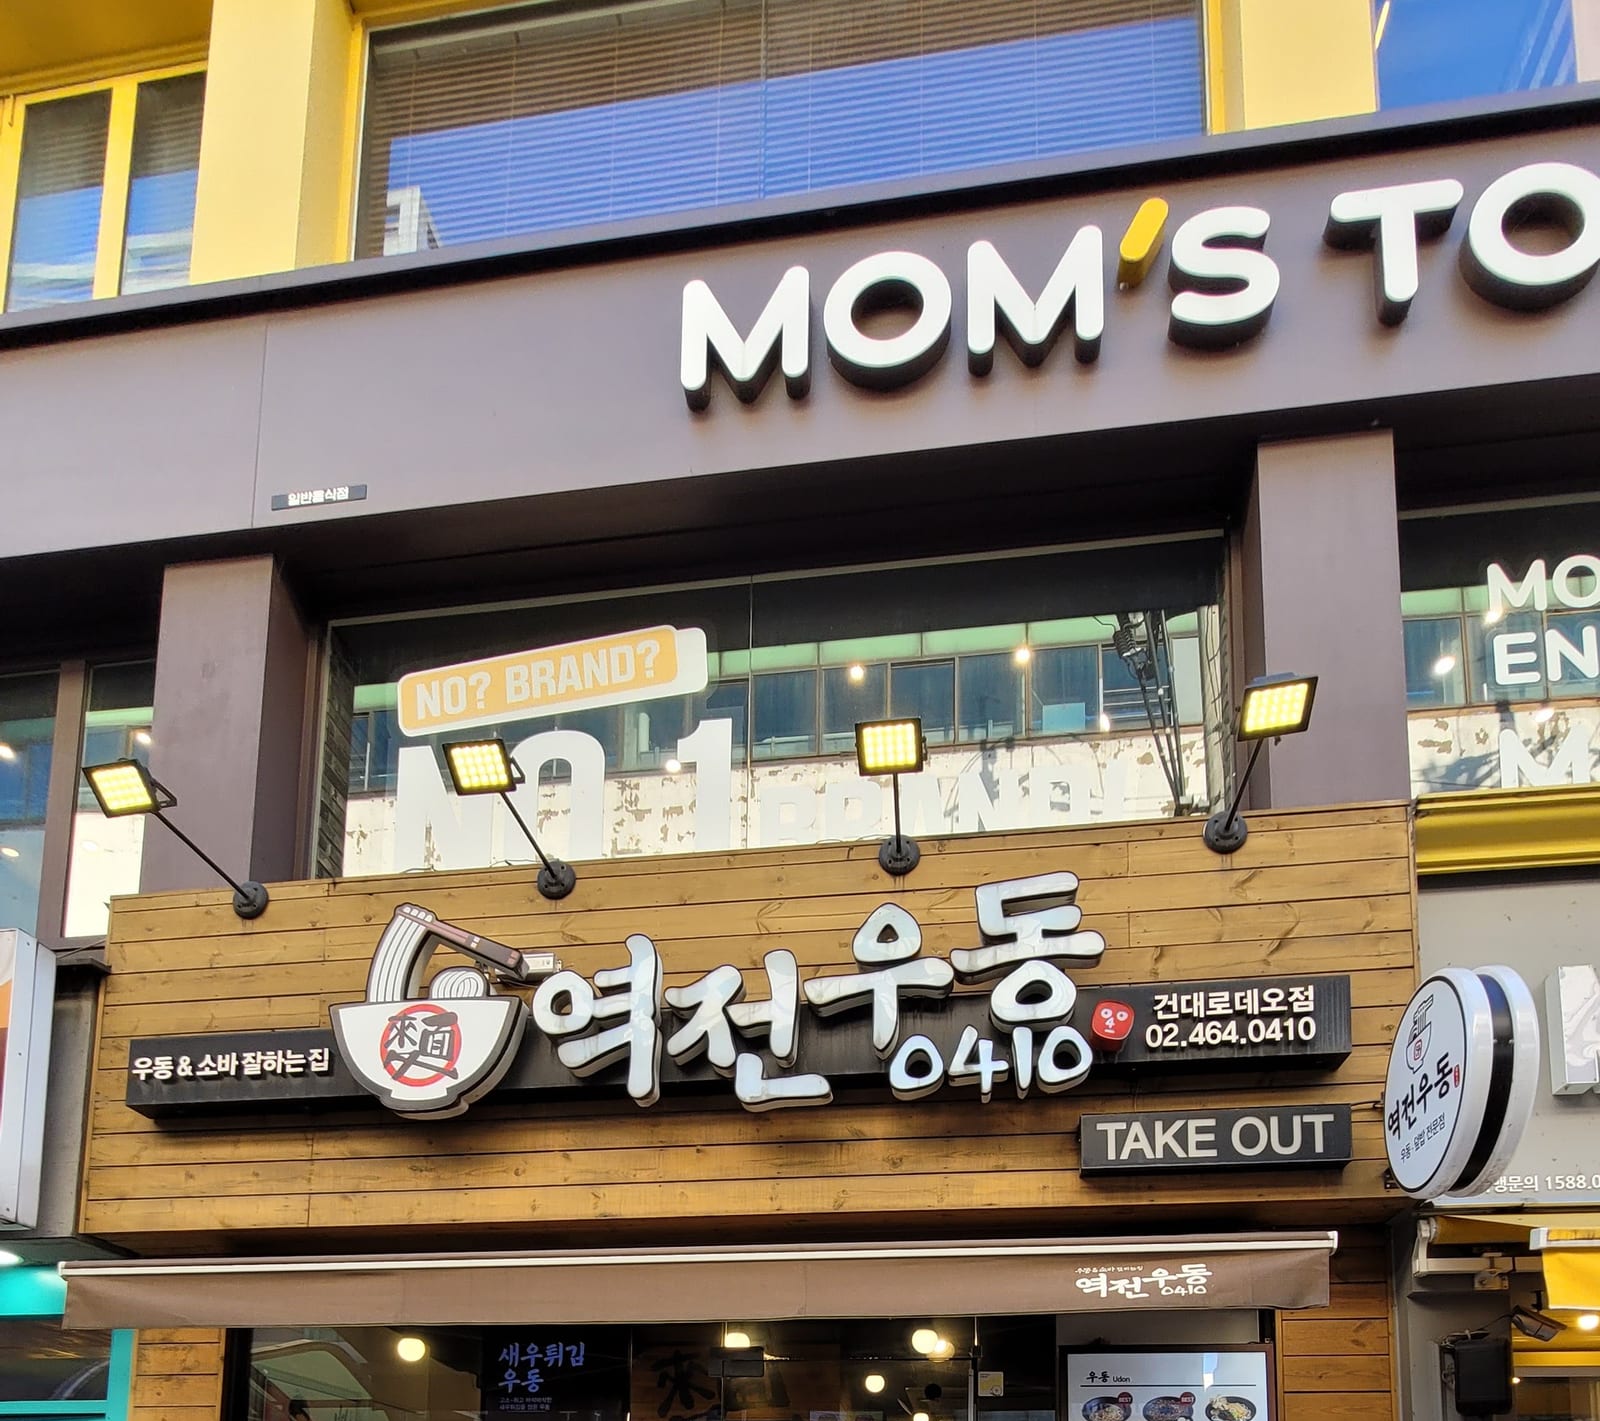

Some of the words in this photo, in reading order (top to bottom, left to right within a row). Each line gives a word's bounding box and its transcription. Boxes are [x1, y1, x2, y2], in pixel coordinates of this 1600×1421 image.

[680, 197, 1282, 412] MOM'S
[288, 486, 349, 506] 일반음식점
[415, 671, 492, 722] NO?
[505, 638, 662, 704] BRAND?
[531, 869, 1107, 1113] 역전우동
[1152, 985, 1315, 1021] 건대로데오점
[1145, 1016, 1317, 1049] 02.464.0410
[132, 1056, 174, 1081] 우동
[177, 1056, 193, 1077] &
[196, 1052, 239, 1076] 소바
[241, 1049, 306, 1076] 잘하는
[308, 1048, 330, 1072] 집
[889, 1024, 1095, 1105] 0410
[1387, 1052, 1453, 1141] 역전우동
[1096, 1118, 1218, 1161] TAKE
[1231, 1114, 1335, 1156] OUT
[1075, 1263, 1213, 1299] 역전우동
[1161, 1285, 1207, 1296] 0410
[498, 1342, 585, 1368] 새우튀김
[498, 1368, 544, 1393] 우동
[1086, 1370, 1111, 1383] 우동
[1112, 1375, 1131, 1383] Udon
